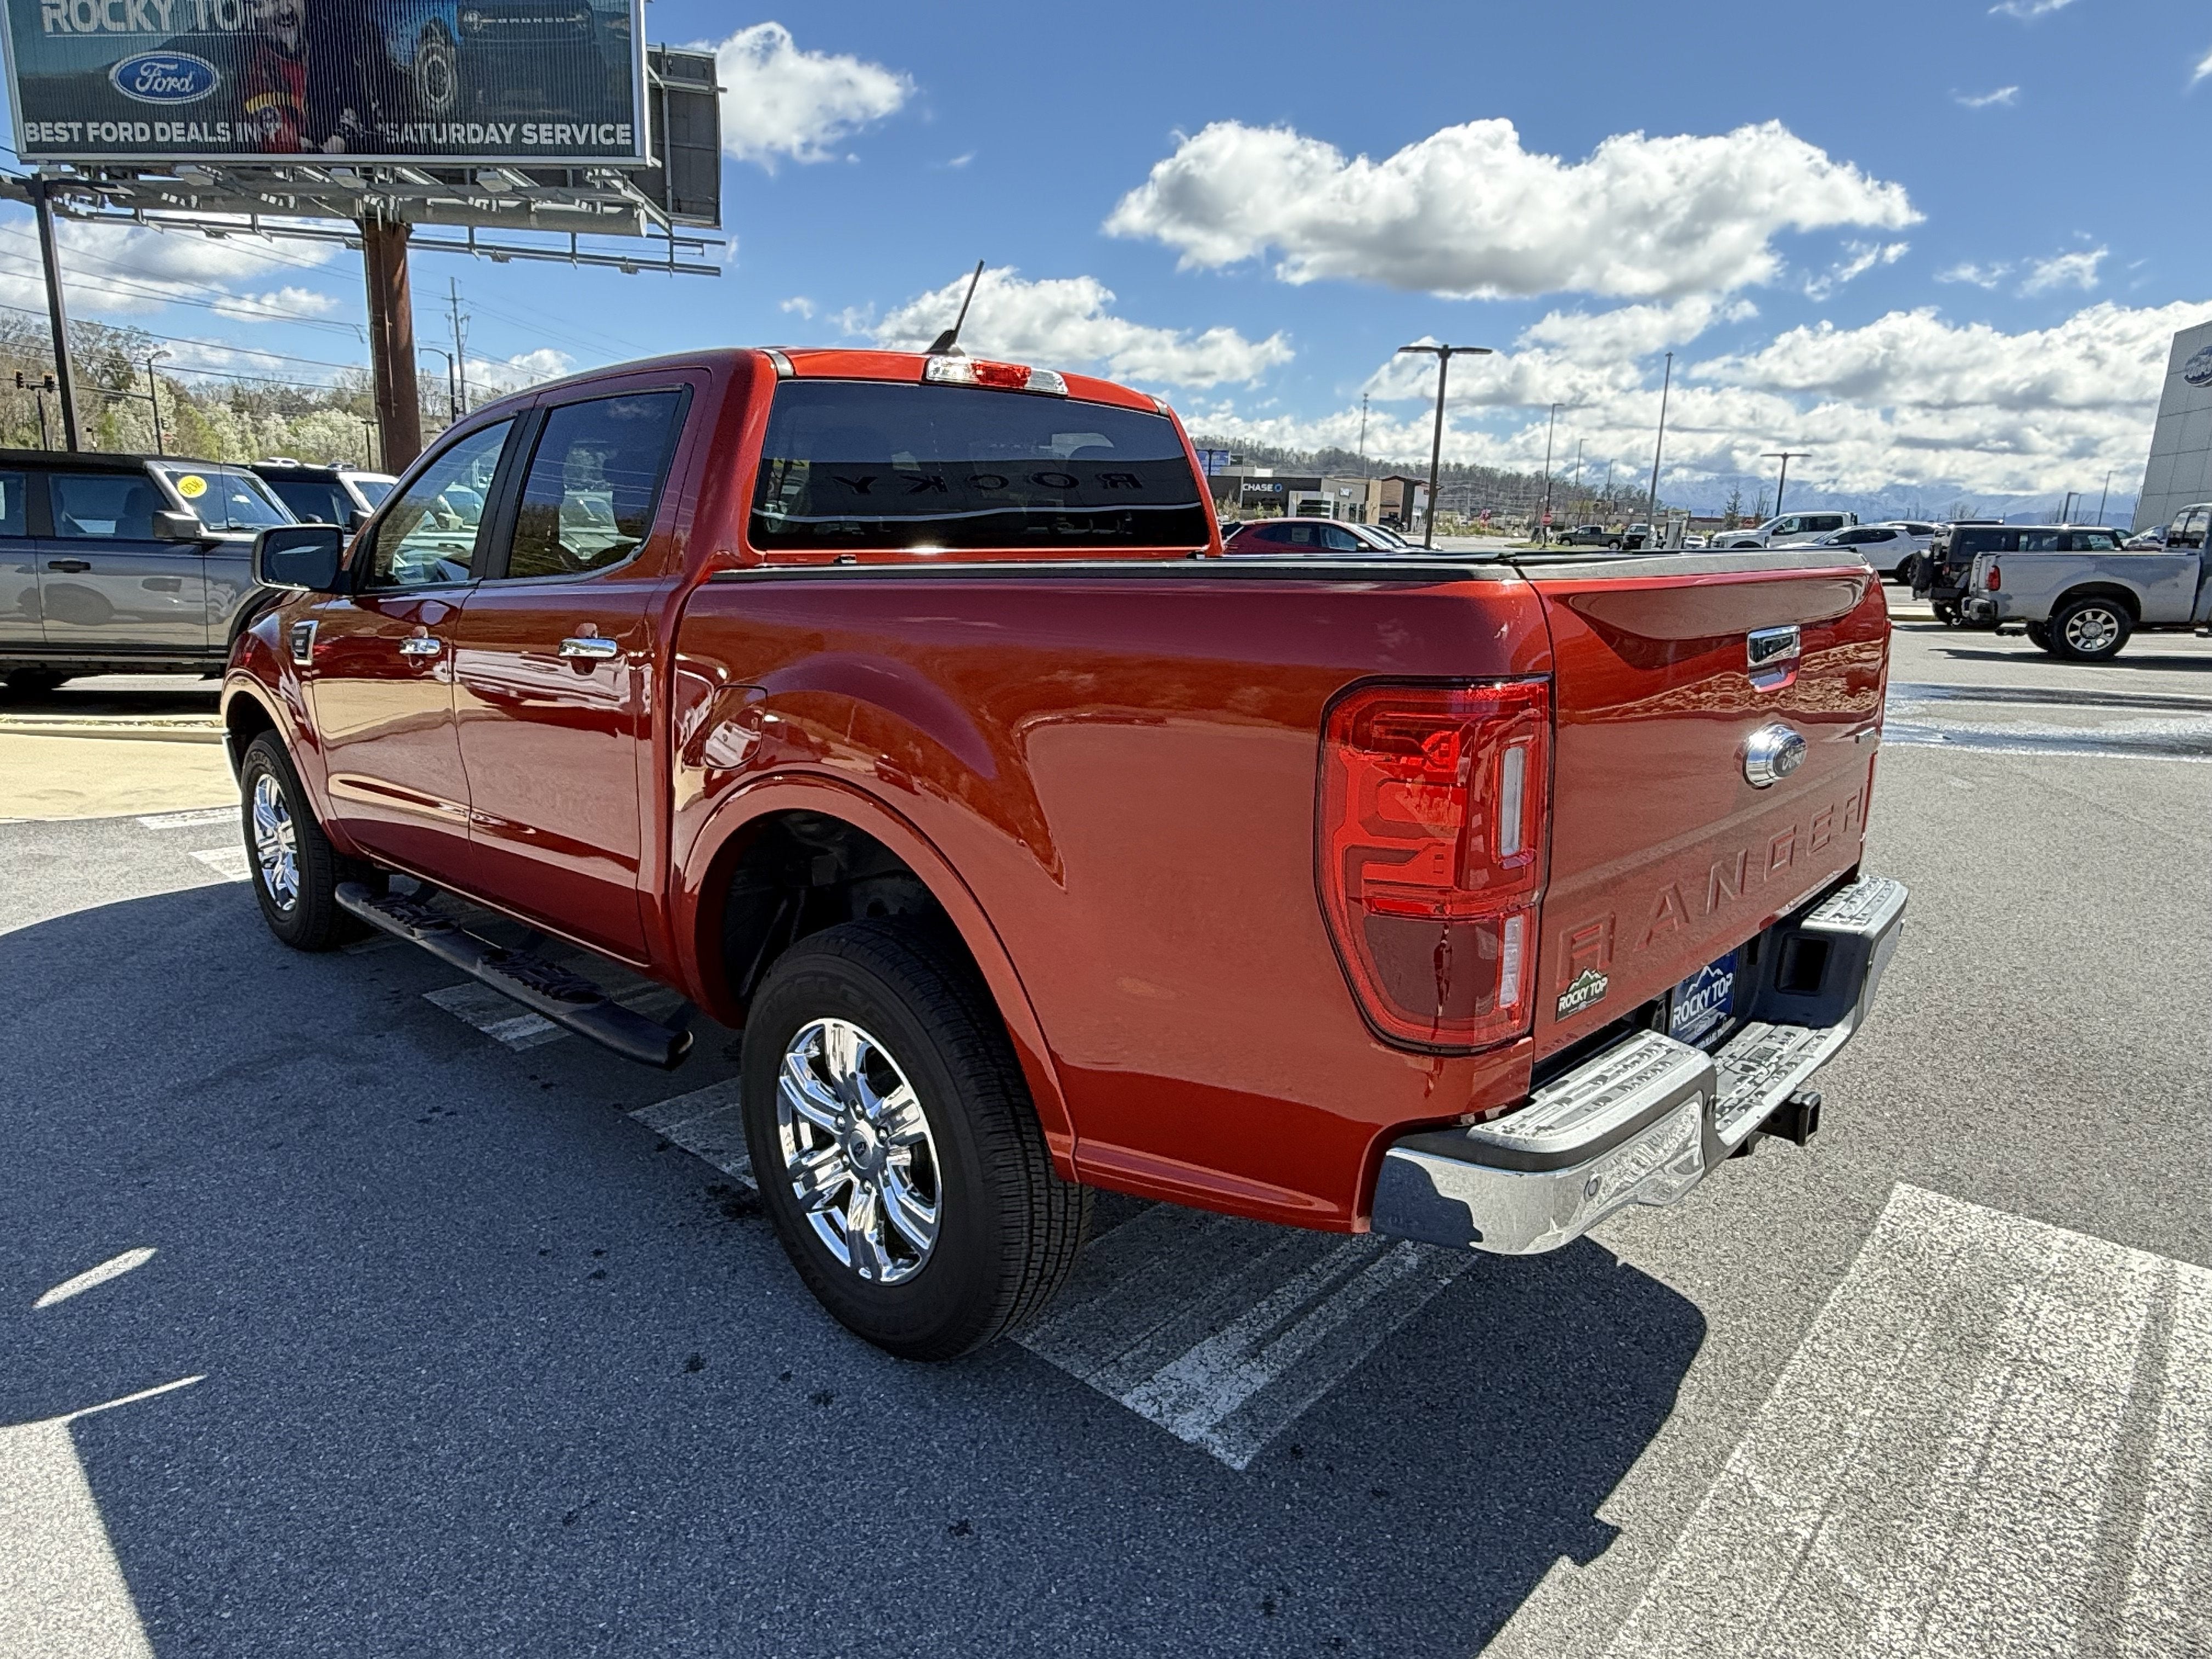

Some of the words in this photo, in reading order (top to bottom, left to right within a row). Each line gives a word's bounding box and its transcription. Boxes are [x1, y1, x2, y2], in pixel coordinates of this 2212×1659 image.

[42, 0, 174, 32] ROCKY
[136, 61, 194, 92] Ford
[25, 122, 82, 143] BEST
[88, 122, 149, 143] FORD
[155, 122, 230, 143] DEALS
[384, 123, 516, 144] SATURDAY
[521, 123, 632, 145] SERVICE
[182, 479, 202, 494] DEMO
[1243, 483, 1273, 492] CHASE
[1556, 787, 1863, 989] RANGER
[1559, 986, 1590, 1012] ROCKY
[1590, 977, 1607, 996] TOP
[1672, 986, 1711, 1028] ROCKY
[1712, 973, 1734, 1002] TOP
